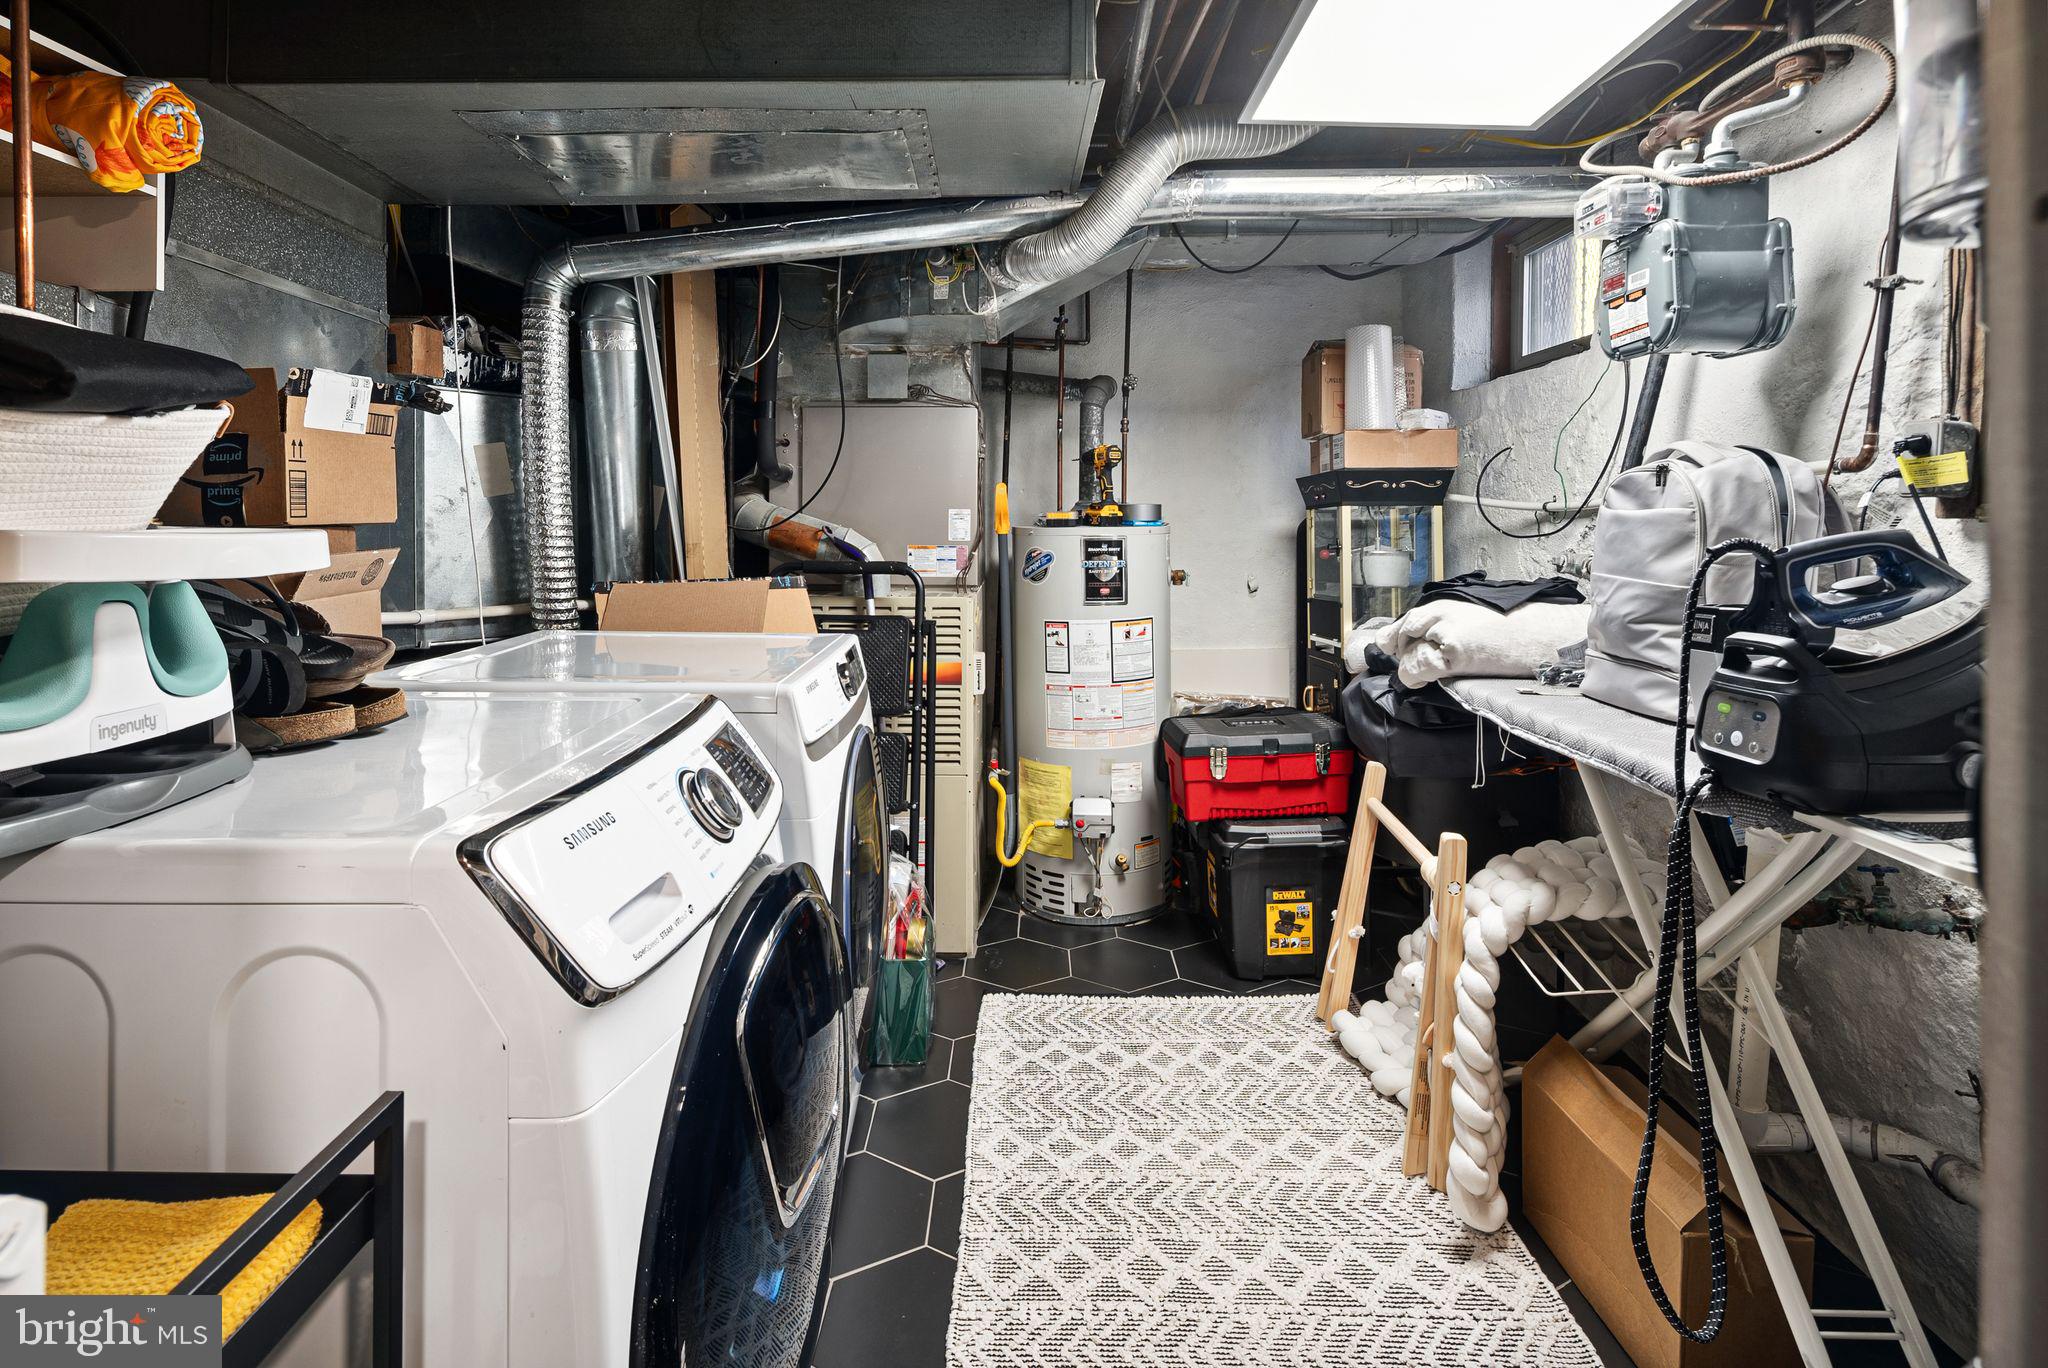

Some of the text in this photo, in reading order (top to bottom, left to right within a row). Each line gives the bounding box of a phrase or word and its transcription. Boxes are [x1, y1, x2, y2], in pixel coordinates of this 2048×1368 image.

[209, 450, 242, 464] prime
[207, 485, 241, 498] prime
[1082, 560, 1126, 568] DEFENDER
[98, 713, 158, 741] ingenuity
[563, 811, 617, 850] SAMSUNG
[659, 925, 674, 940] STEAM
